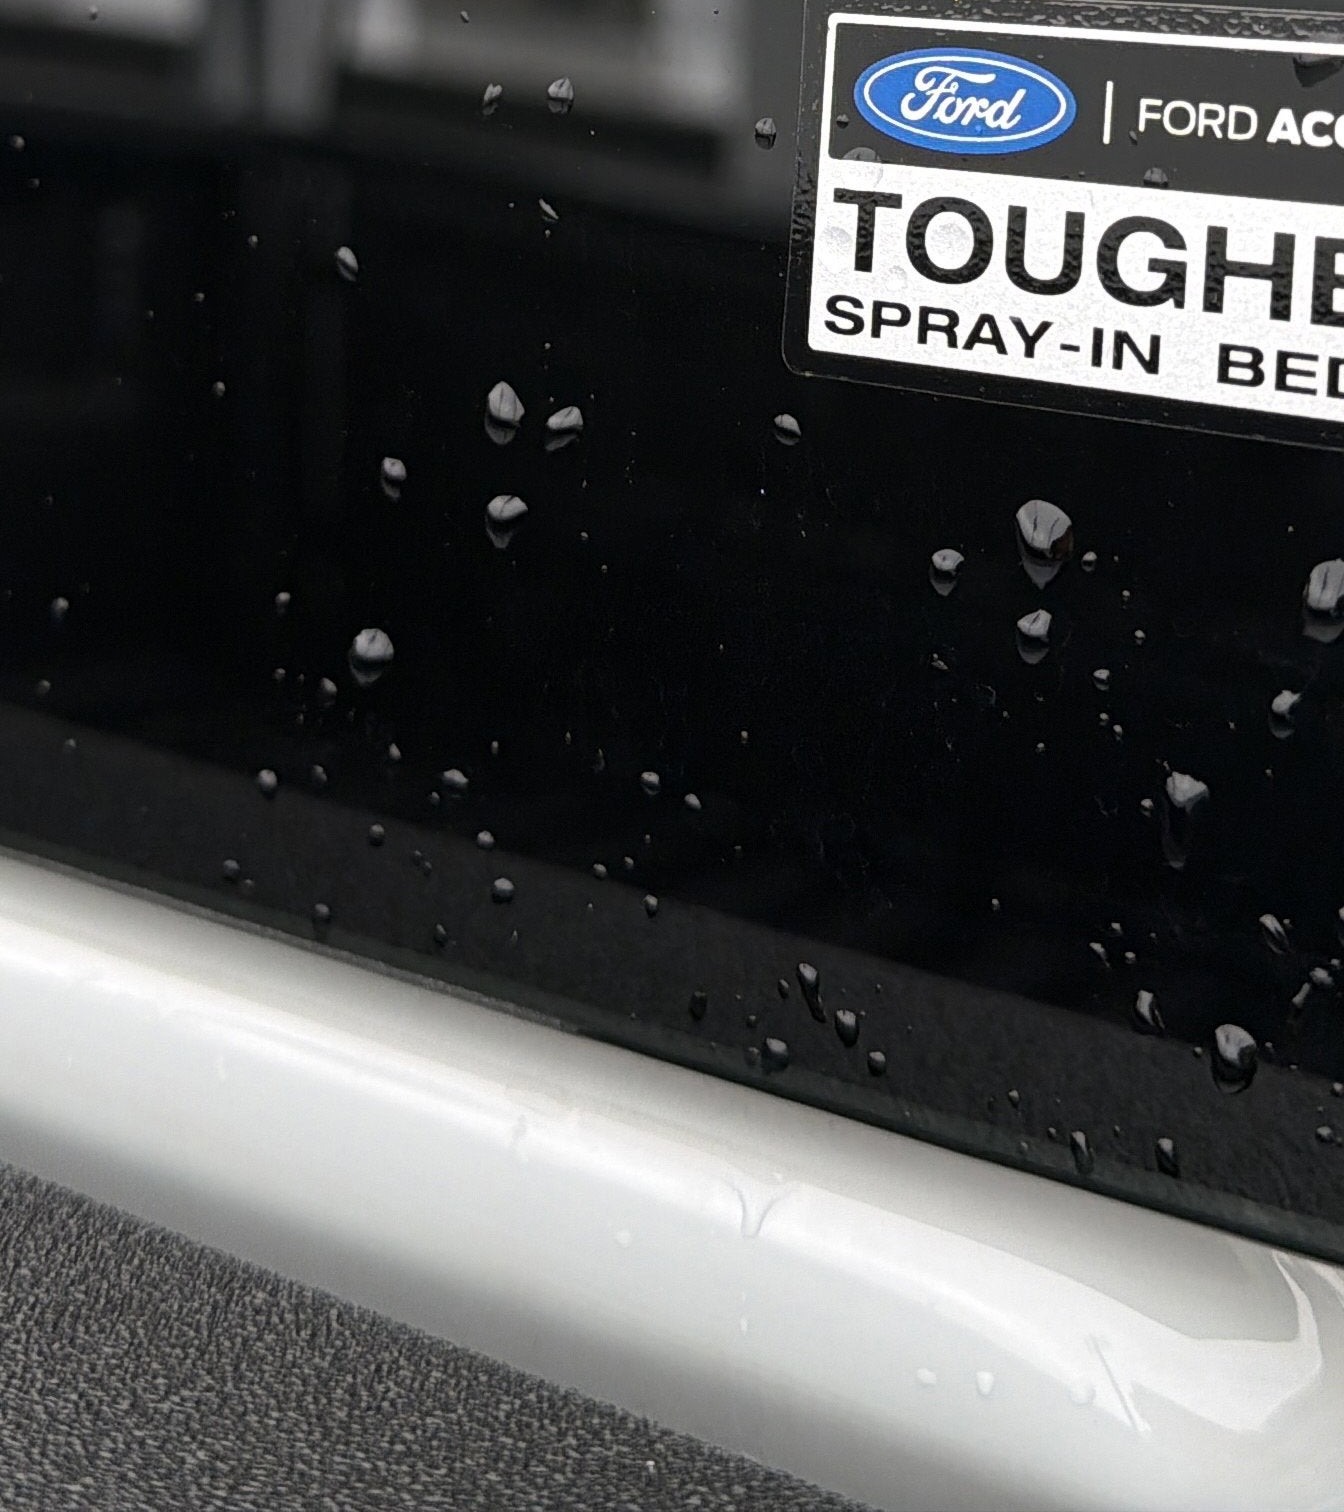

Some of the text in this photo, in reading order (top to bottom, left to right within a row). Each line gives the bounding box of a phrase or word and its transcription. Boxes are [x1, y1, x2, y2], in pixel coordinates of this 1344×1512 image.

[900, 65, 1027, 131] Ford
[1138, 97, 1257, 143] FORD
[824, 295, 1162, 376] SPRAY-IN
